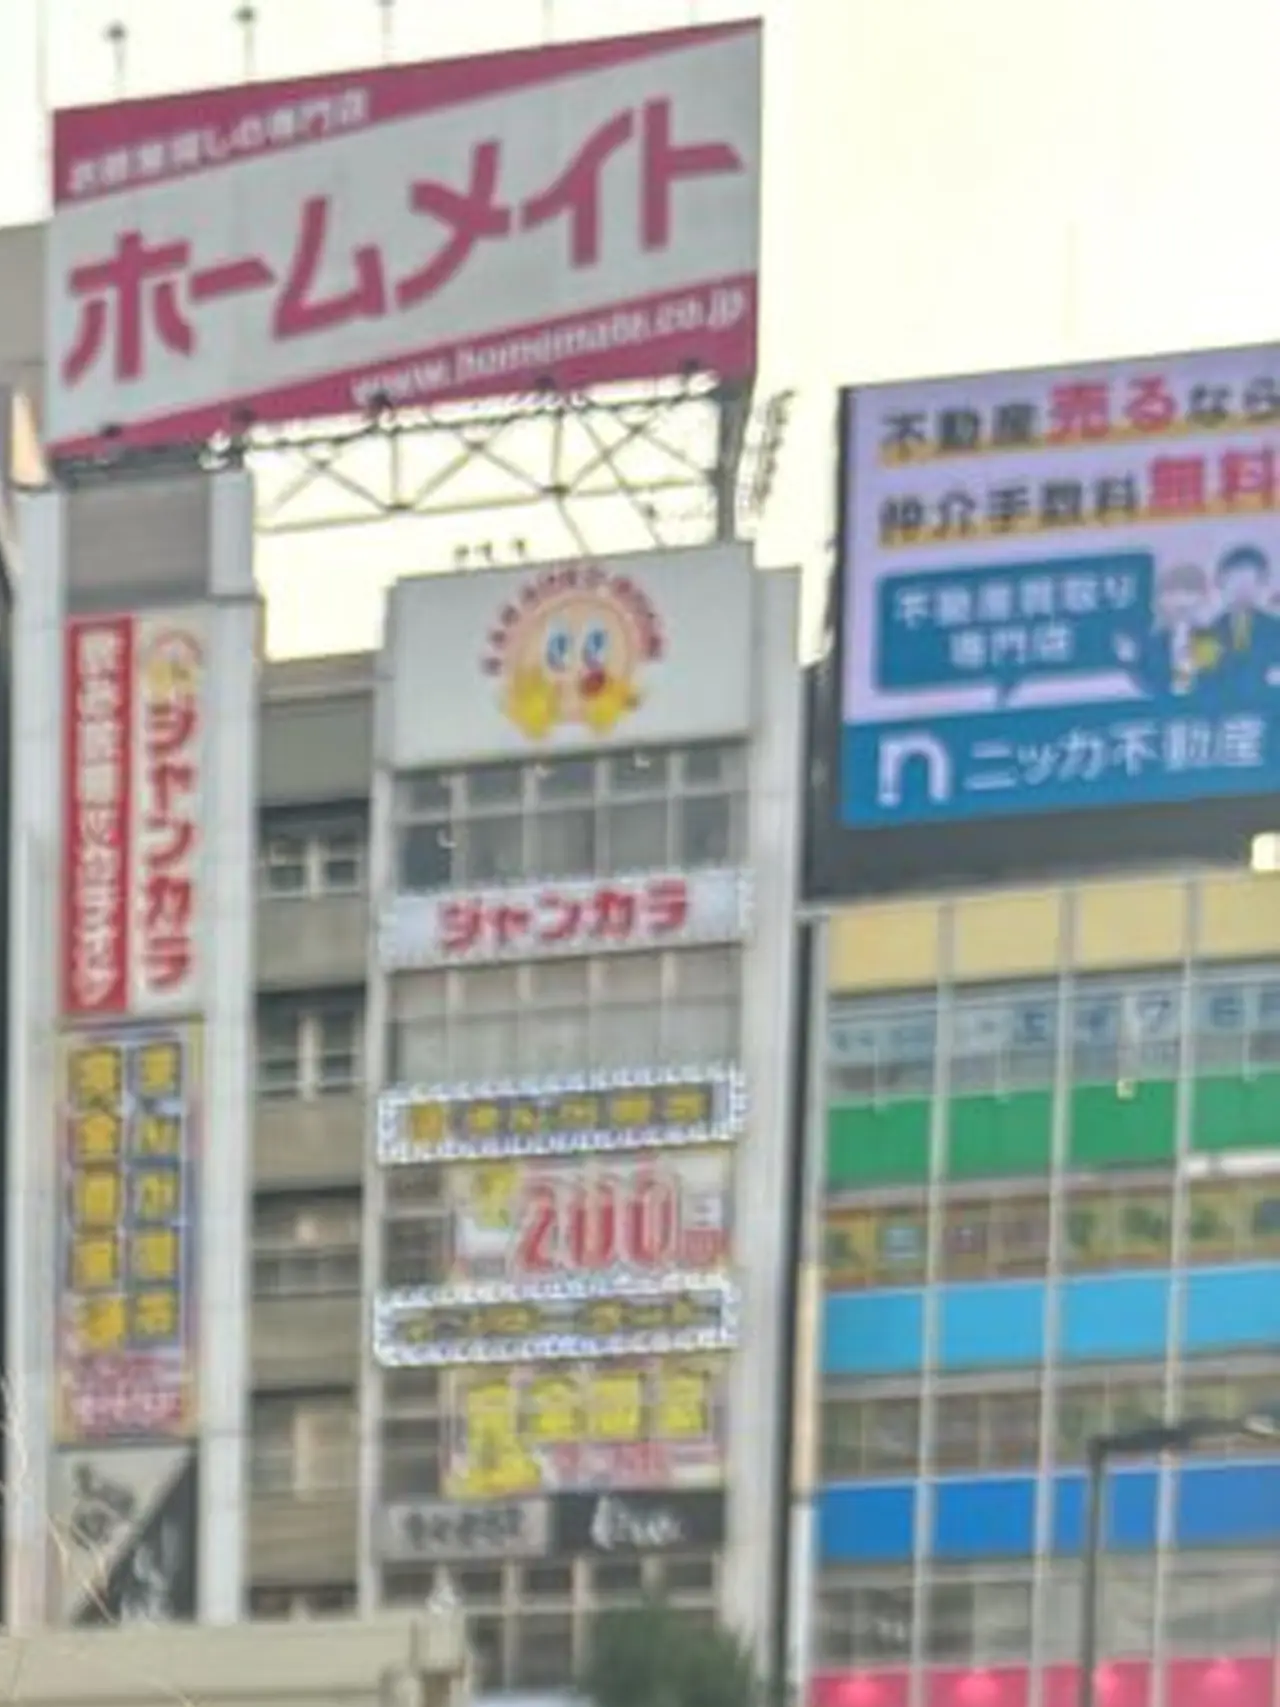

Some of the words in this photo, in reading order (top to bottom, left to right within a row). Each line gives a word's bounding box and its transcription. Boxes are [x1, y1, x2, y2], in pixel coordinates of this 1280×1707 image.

[59, 95, 746, 387] ホームメイト
[878, 446, 1278, 542] 仲介手数料無料
[964, 716, 1267, 790] ニッカ不動産
[144, 697, 199, 993] ジャンカラ
[436, 876, 693, 957] ジャンカラ
